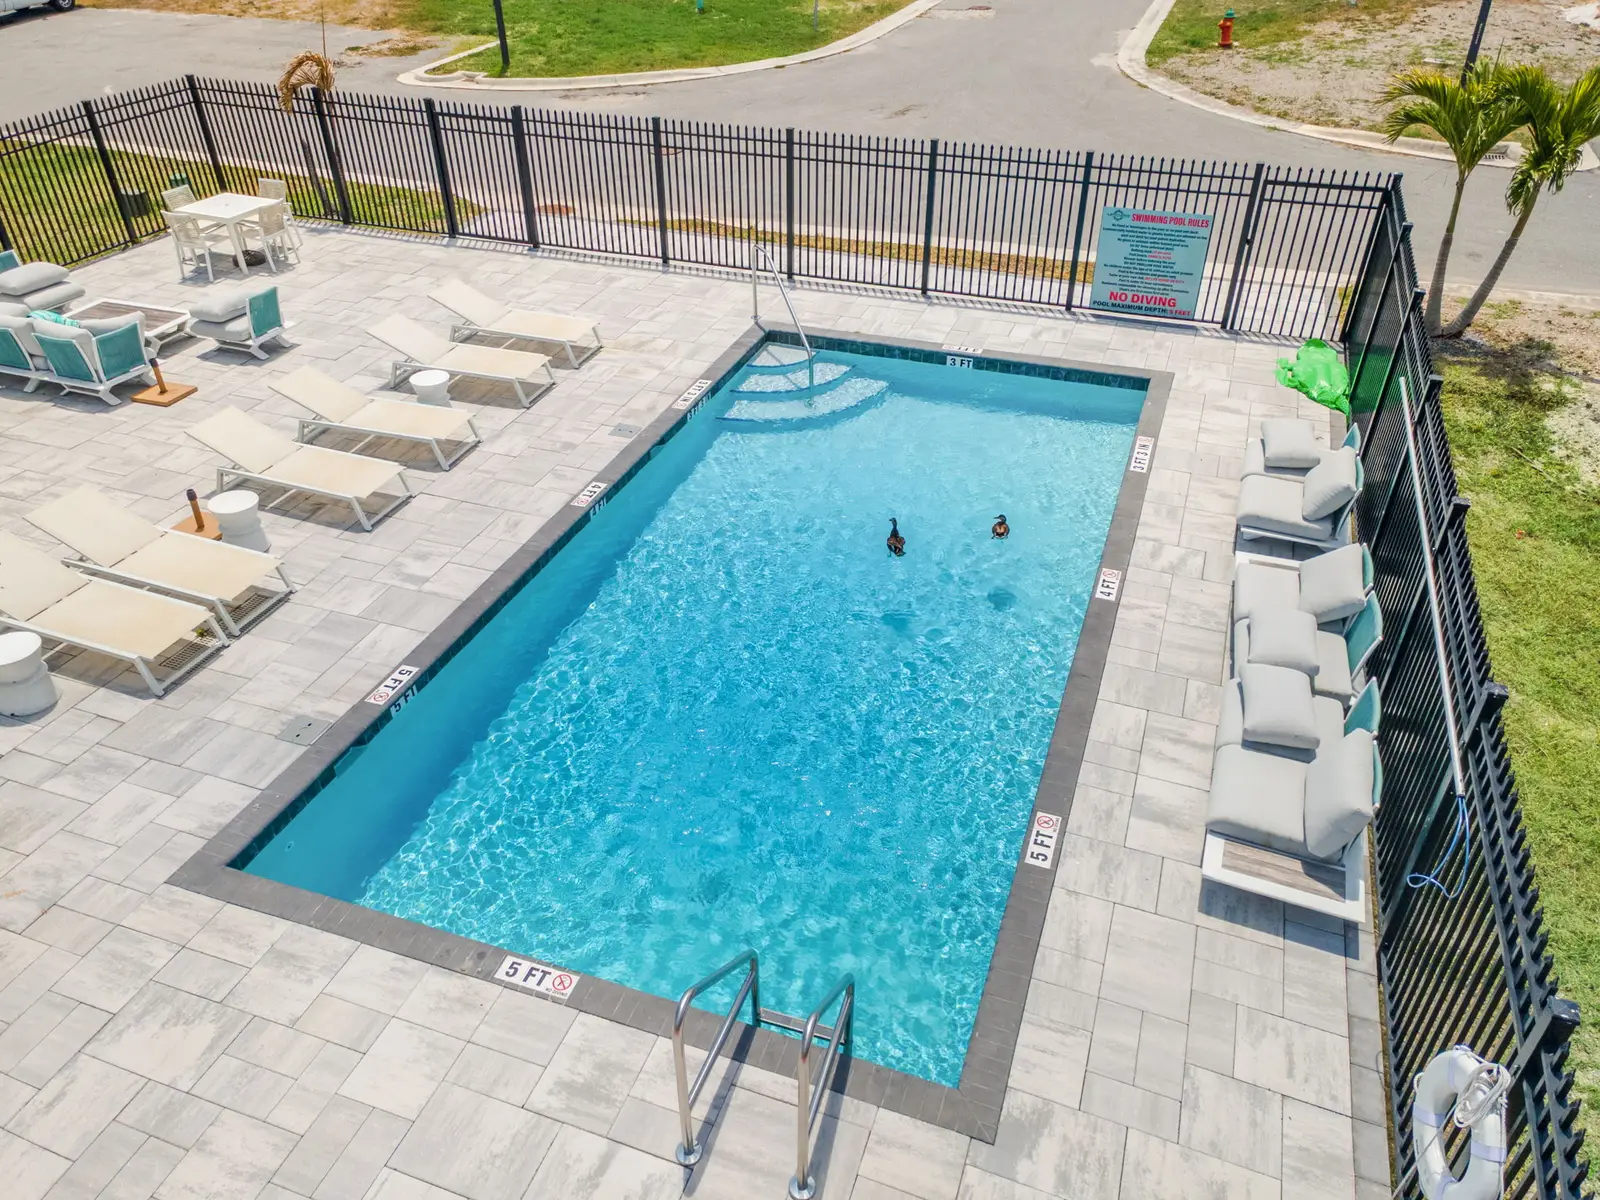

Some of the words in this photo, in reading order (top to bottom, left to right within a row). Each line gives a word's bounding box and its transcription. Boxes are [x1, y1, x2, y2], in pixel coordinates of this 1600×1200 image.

[1131, 213, 1168, 225] SWIMMING
[1168, 216, 1187, 226] POOL
[1187, 218, 1209, 228] RULES
[1092, 300, 1110, 308] POOL
[1111, 302, 1144, 311] MAXIMUM
[1109, 291, 1128, 302] NO
[1130, 293, 1177, 308] DIVING
[950, 357, 956, 366] 3
[960, 358, 972, 368] FT
[1134, 456, 1147, 465] FT
[582, 489, 597, 498] FT
[1101, 578, 1116, 590] FT
[383, 678, 404, 691] FT
[1033, 830, 1053, 849] FT
[1030, 851, 1048, 862] 5
[505, 961, 522, 978] 5
[522, 966, 552, 987] FT
